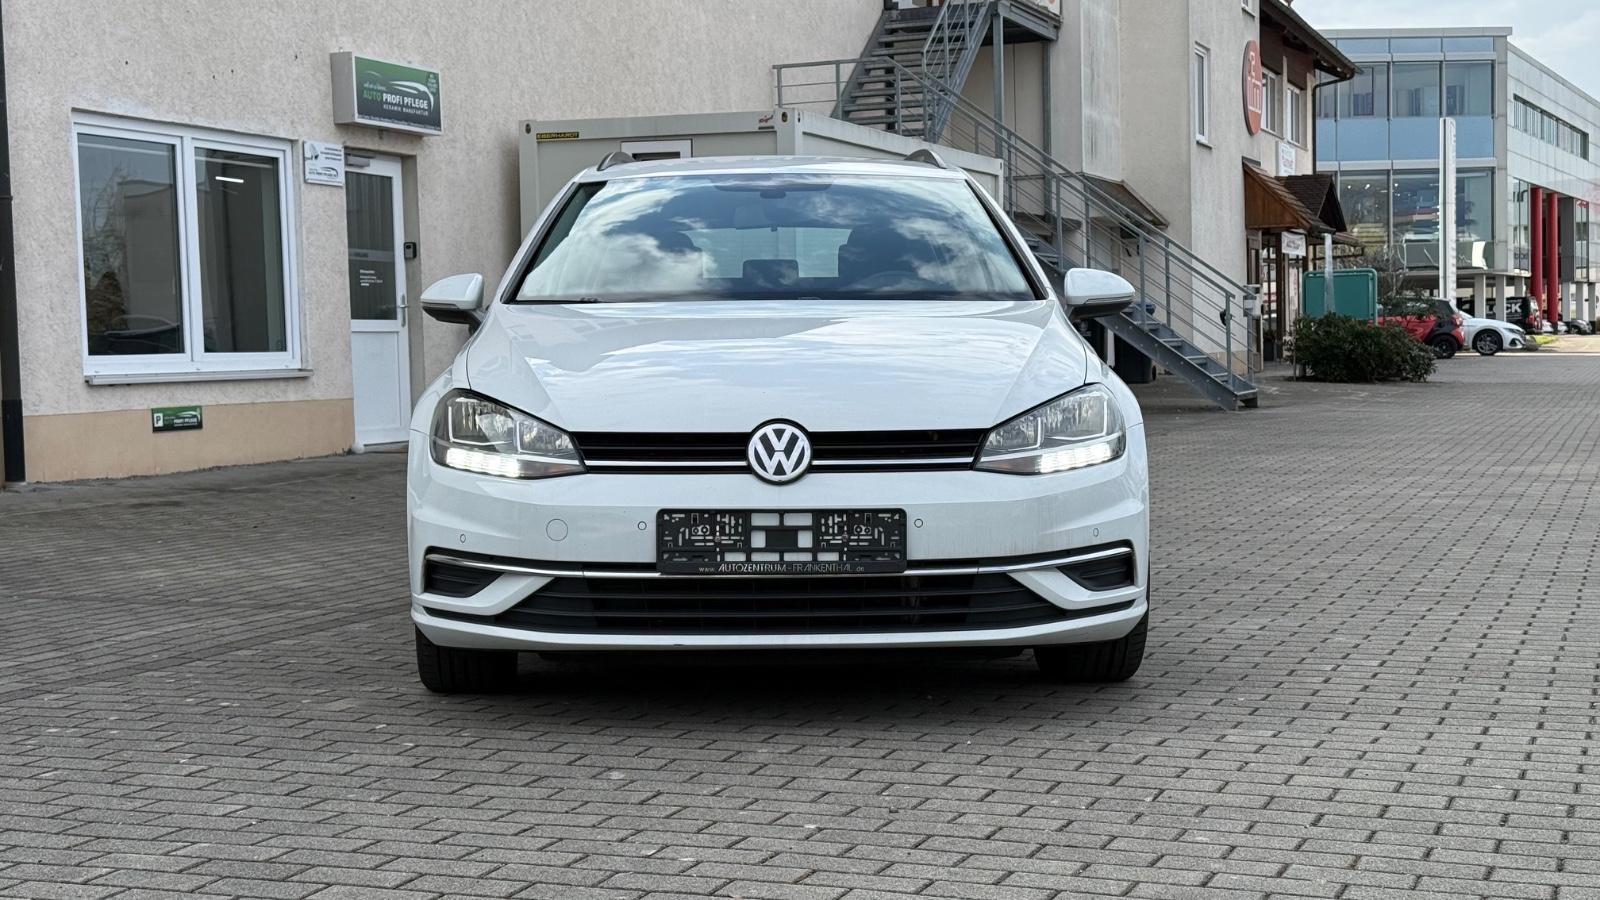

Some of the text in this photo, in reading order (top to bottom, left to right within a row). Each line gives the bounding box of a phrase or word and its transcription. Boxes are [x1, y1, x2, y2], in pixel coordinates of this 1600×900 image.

[363, 89, 428, 109] AUTO PROFI PFLEGE
[156, 415, 161, 425] P
